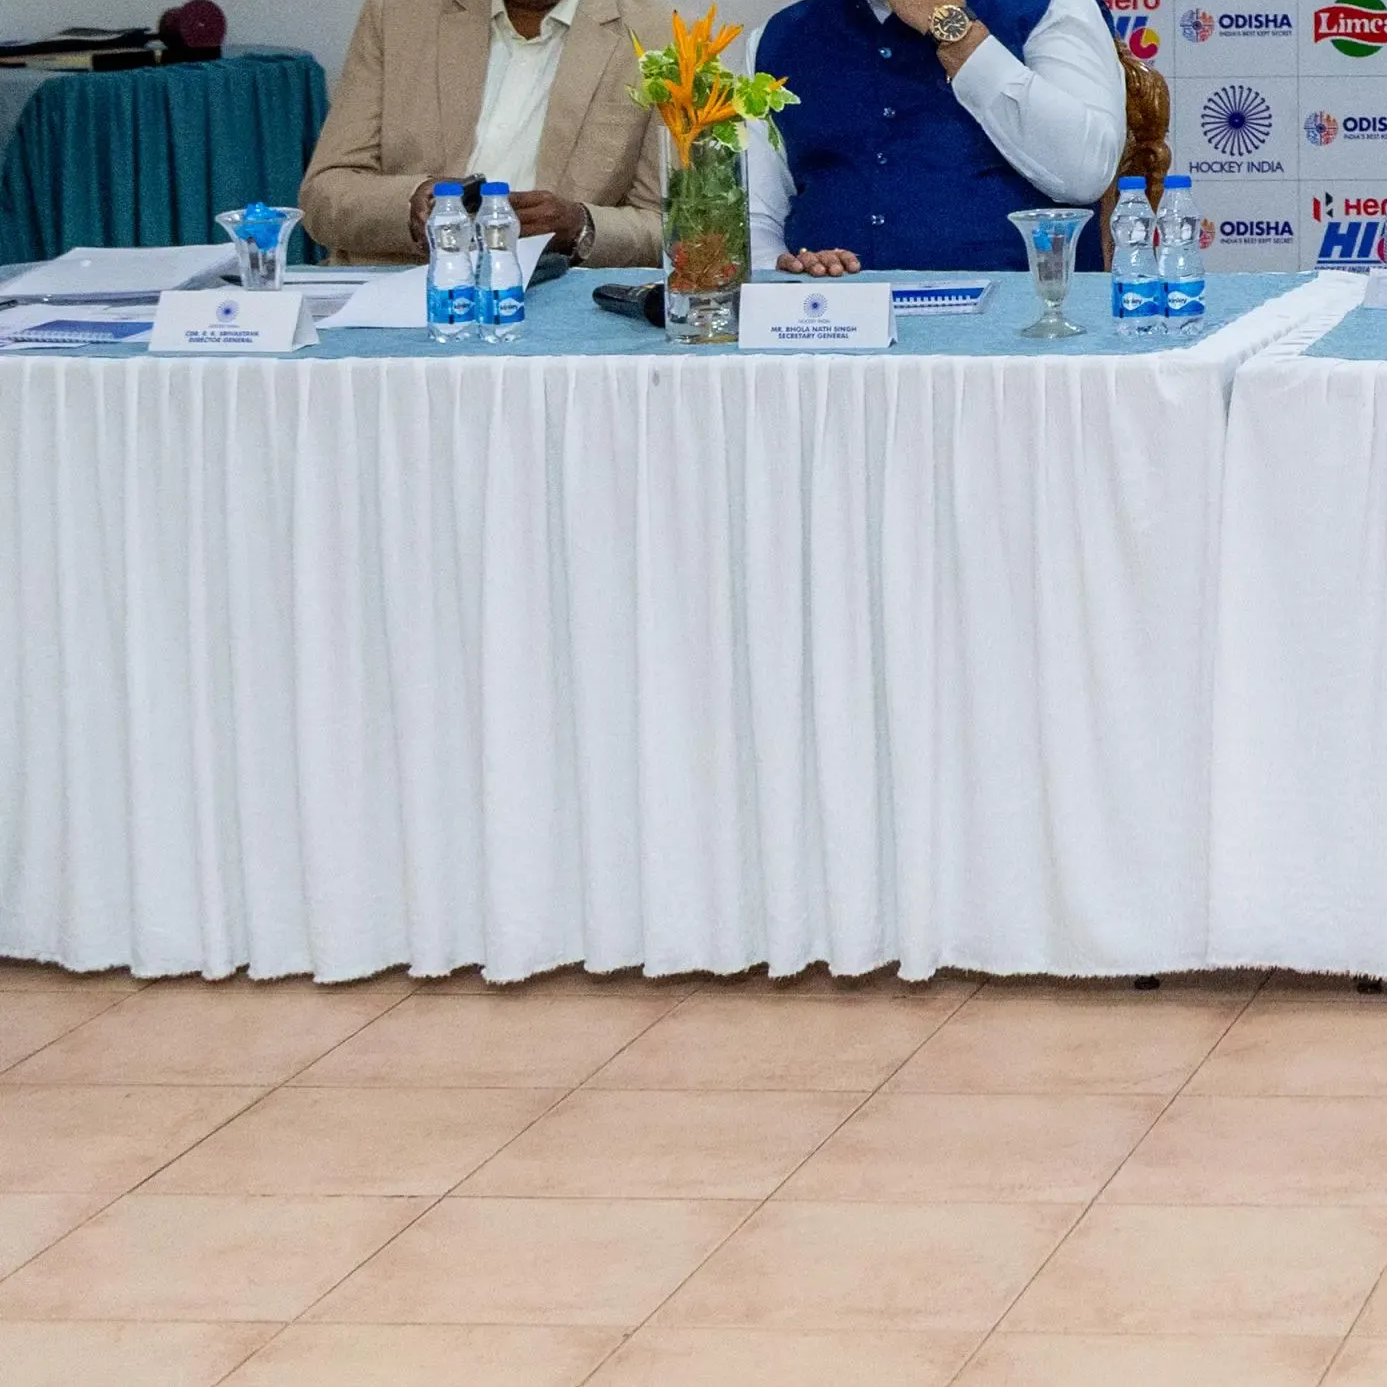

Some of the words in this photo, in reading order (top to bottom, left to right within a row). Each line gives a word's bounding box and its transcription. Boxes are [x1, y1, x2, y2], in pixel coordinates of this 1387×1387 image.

[1219, 14, 1293, 29] ODISHA
[1189, 161, 1243, 174] HOCKEY
[1247, 161, 1284, 173] INDIA
[1345, 198, 1387, 216] Her
[1220, 221, 1294, 236] ODISHA
